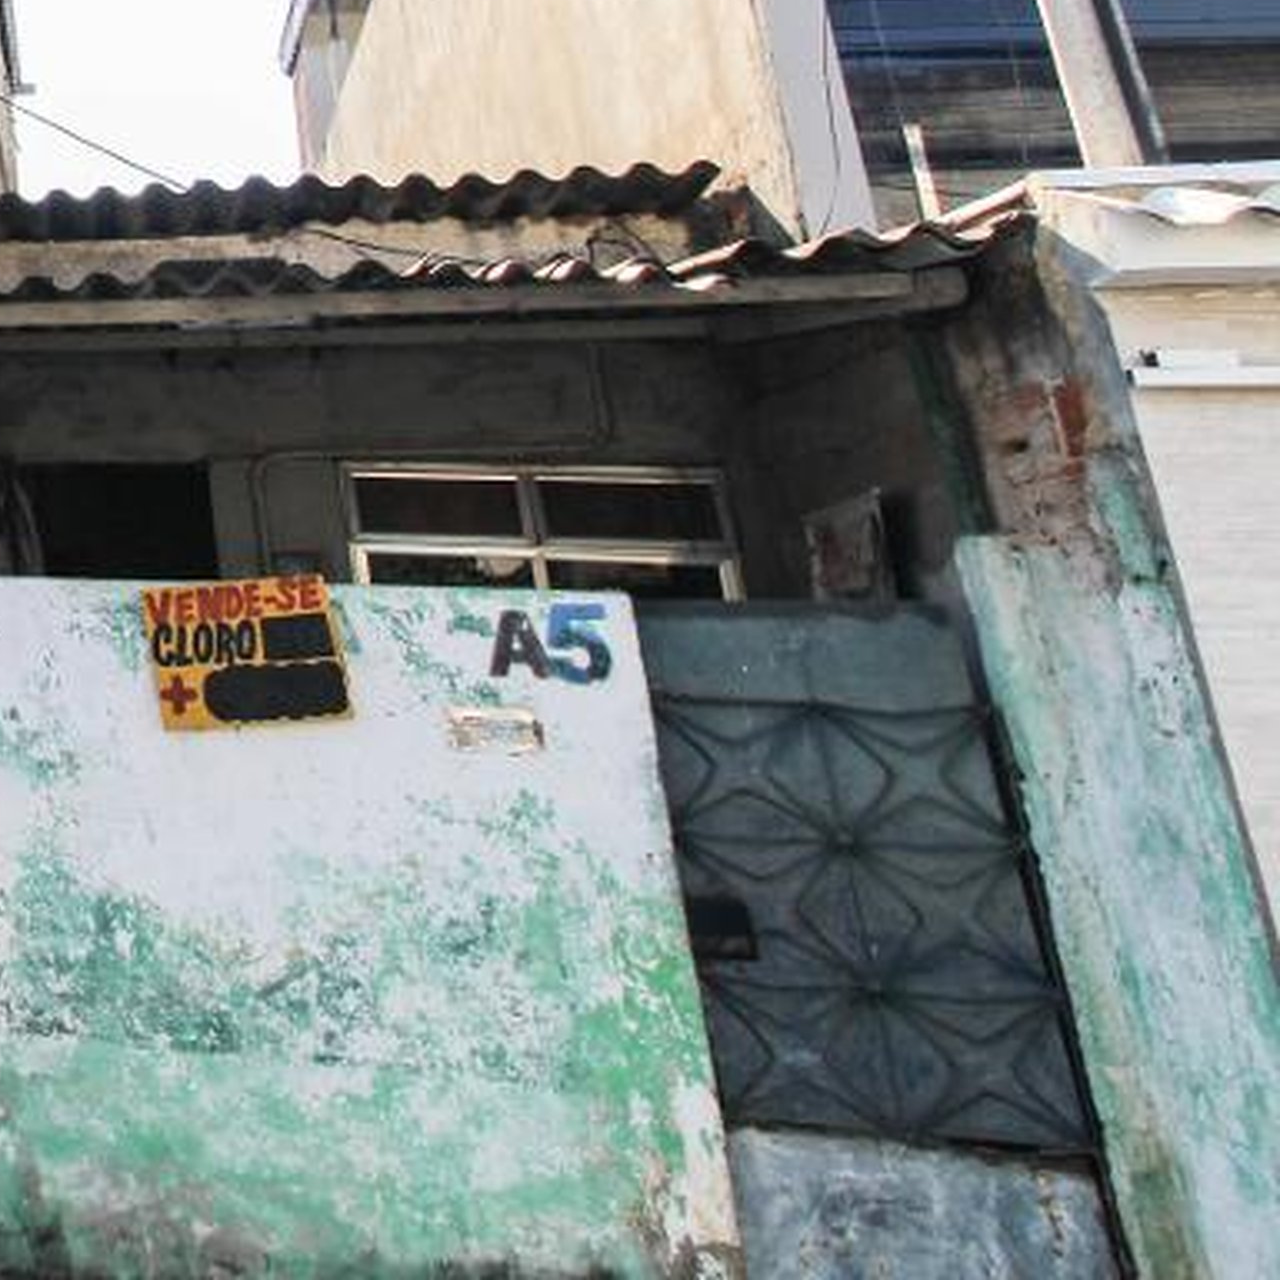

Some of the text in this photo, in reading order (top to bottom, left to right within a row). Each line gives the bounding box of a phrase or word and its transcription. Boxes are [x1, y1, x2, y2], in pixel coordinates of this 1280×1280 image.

[144, 577, 321, 624] VENDE-SE
[153, 620, 256, 667] CLORO
[490, 603, 611, 684] A5
